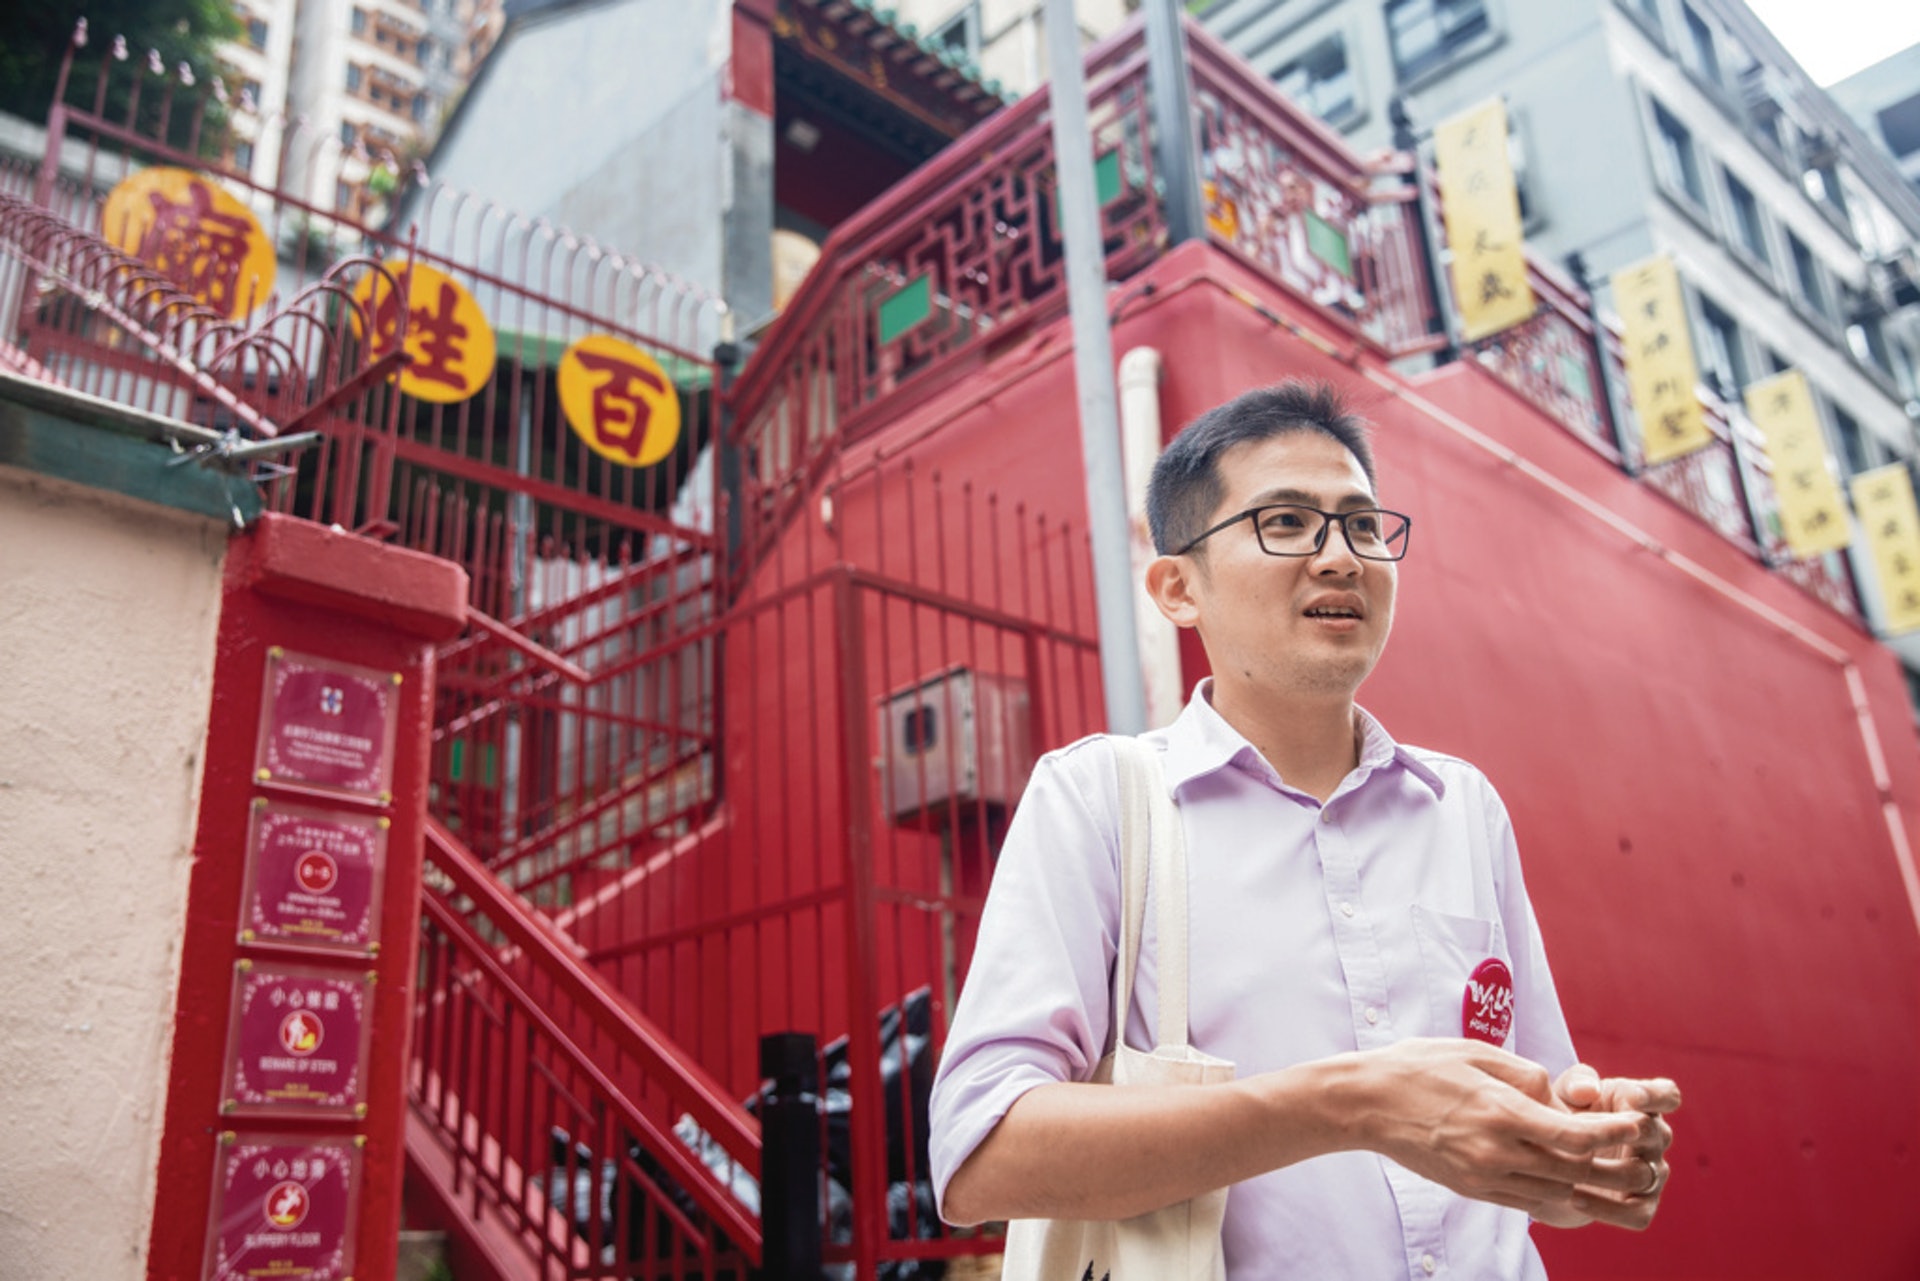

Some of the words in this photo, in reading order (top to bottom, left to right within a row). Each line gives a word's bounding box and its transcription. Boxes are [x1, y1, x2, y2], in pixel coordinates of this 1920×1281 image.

[363, 272, 468, 391] 姓
[575, 349, 665, 459] 百
[1467, 980, 1513, 1019] WALK
